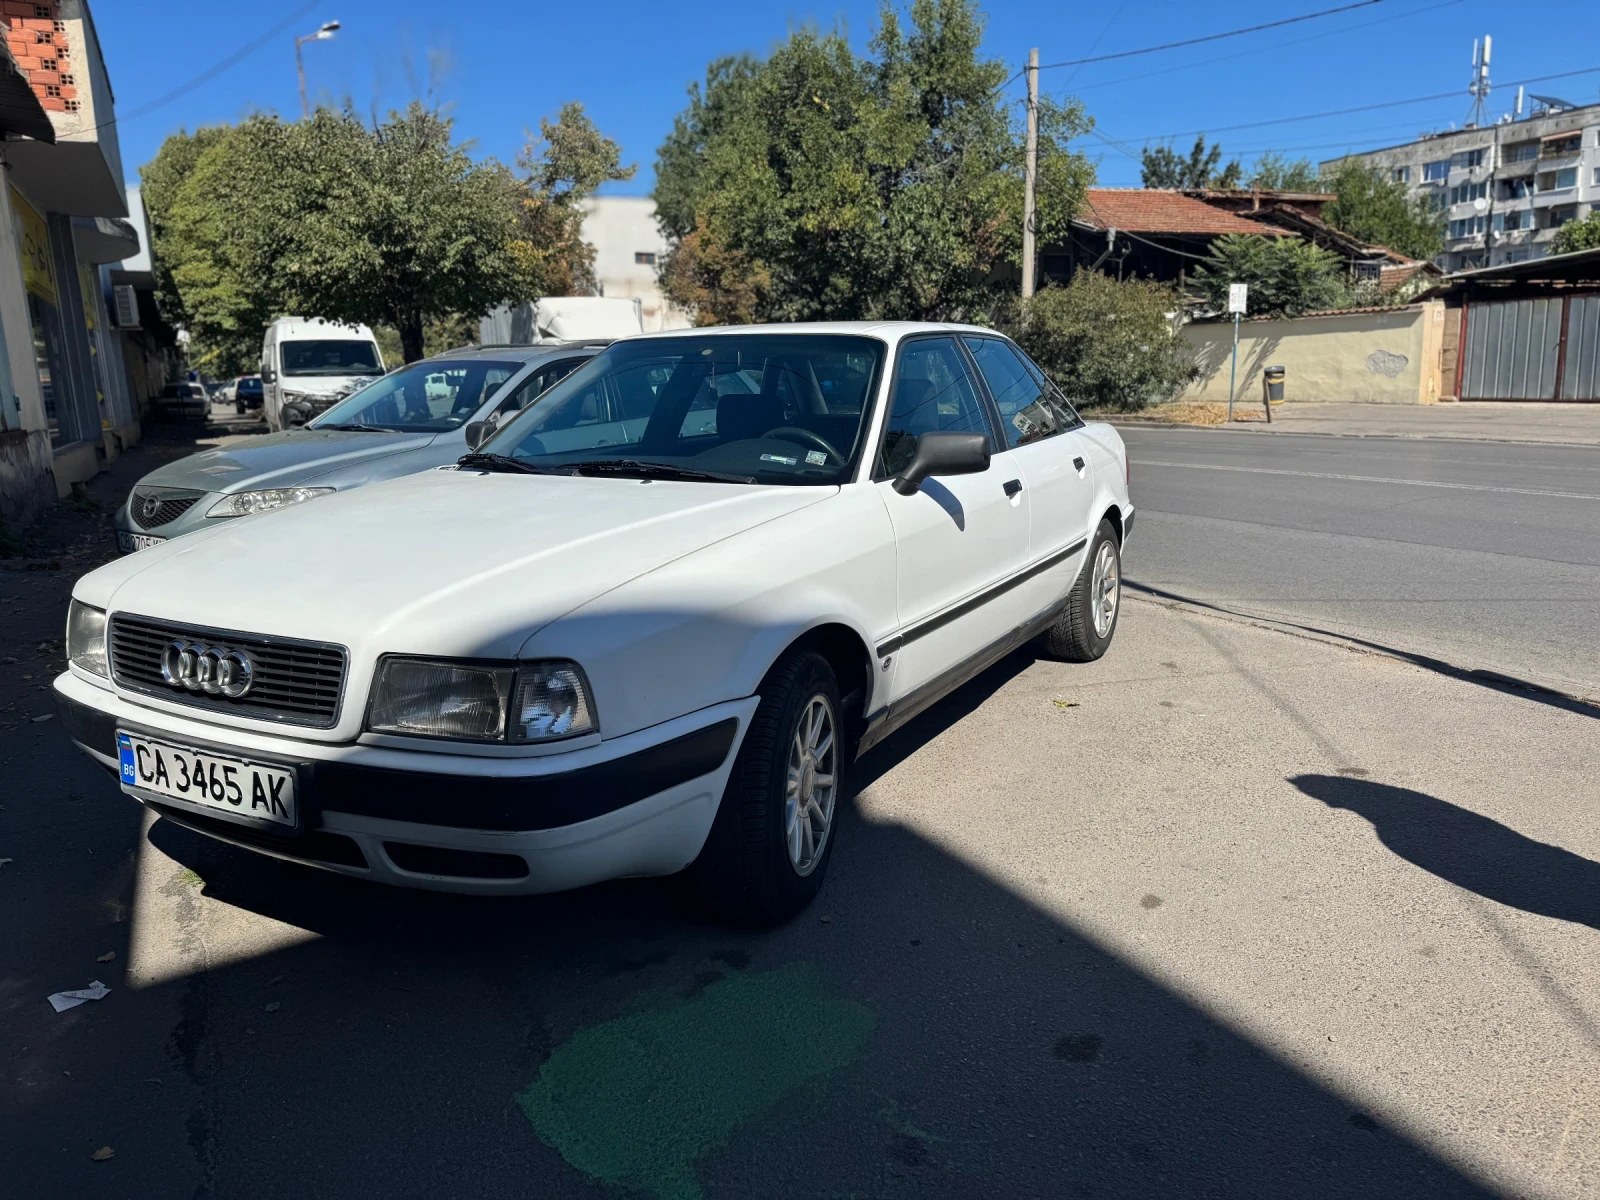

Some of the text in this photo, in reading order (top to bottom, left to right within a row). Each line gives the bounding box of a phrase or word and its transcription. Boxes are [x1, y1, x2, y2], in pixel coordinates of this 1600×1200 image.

[123, 764, 135, 777] BG
[136, 744, 290, 819] CA 3465 AK
